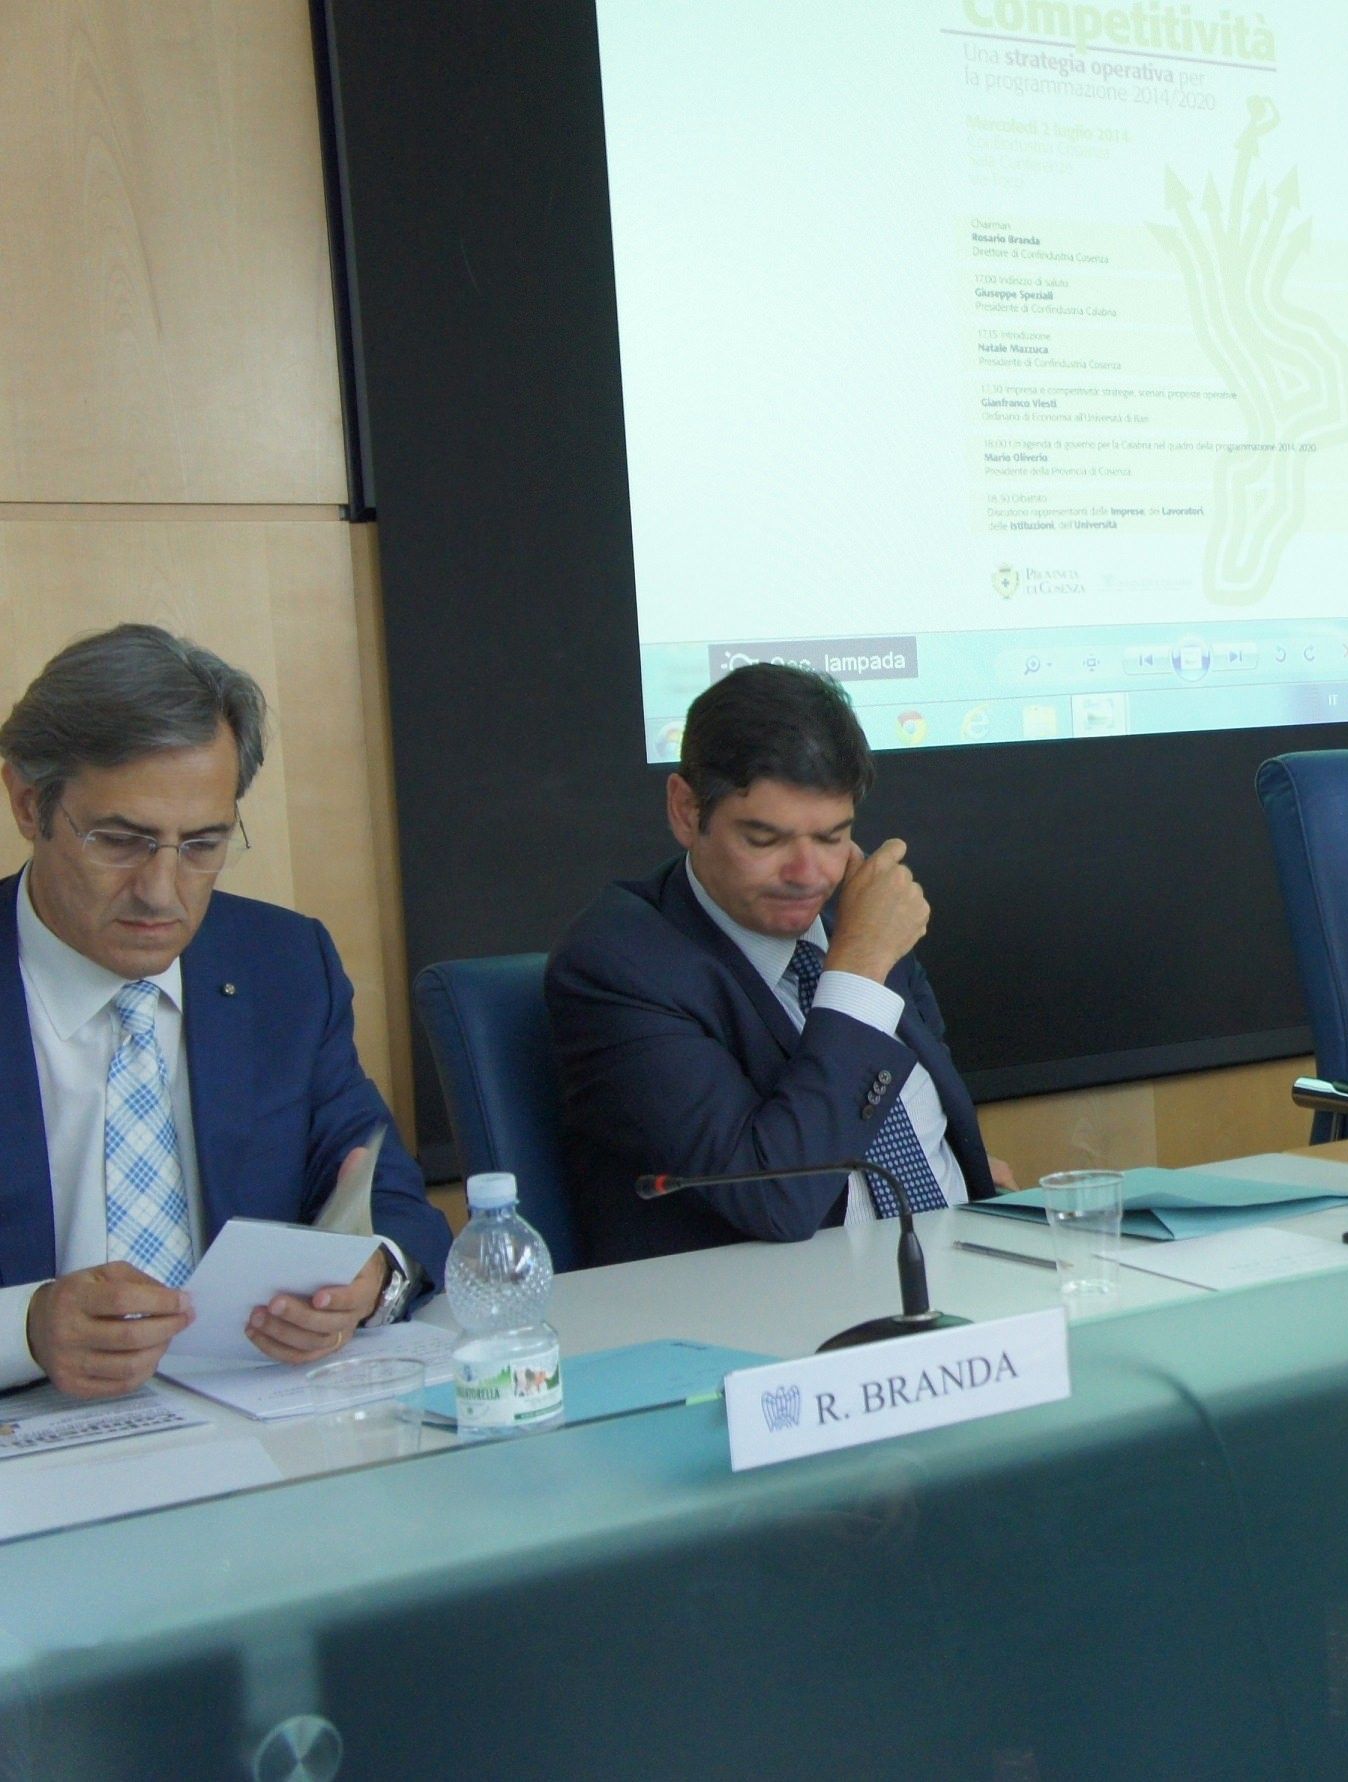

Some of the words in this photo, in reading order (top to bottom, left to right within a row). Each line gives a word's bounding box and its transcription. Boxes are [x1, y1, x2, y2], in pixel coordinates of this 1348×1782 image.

[962, 0, 1277, 61] Competitività
[963, 42, 999, 63] Una
[1004, 49, 1086, 77] strategia
[1090, 58, 1174, 84] operativa
[1179, 70, 1206, 90] per
[964, 65, 980, 86] la
[985, 71, 1128, 101] programmazione
[1132, 83, 1217, 111] 2014/2020
[971, 232, 1006, 243] Rosario
[1008, 234, 1041, 246] Branda
[975, 288, 1017, 300] Giuseppe
[1019, 289, 1053, 301] Speziali
[978, 343, 1007, 354] Natale
[1010, 344, 1049, 354] Mazzuca
[981, 398, 1030, 408] Gianfranco
[1032, 399, 1057, 408] Viesti
[984, 453, 1011, 462] Mario
[1013, 453, 1048, 462] Oliverio
[825, 651, 906, 675] lampada
[815, 1392, 850, 1426] R.
[860, 1350, 1020, 1415] BRANDA
